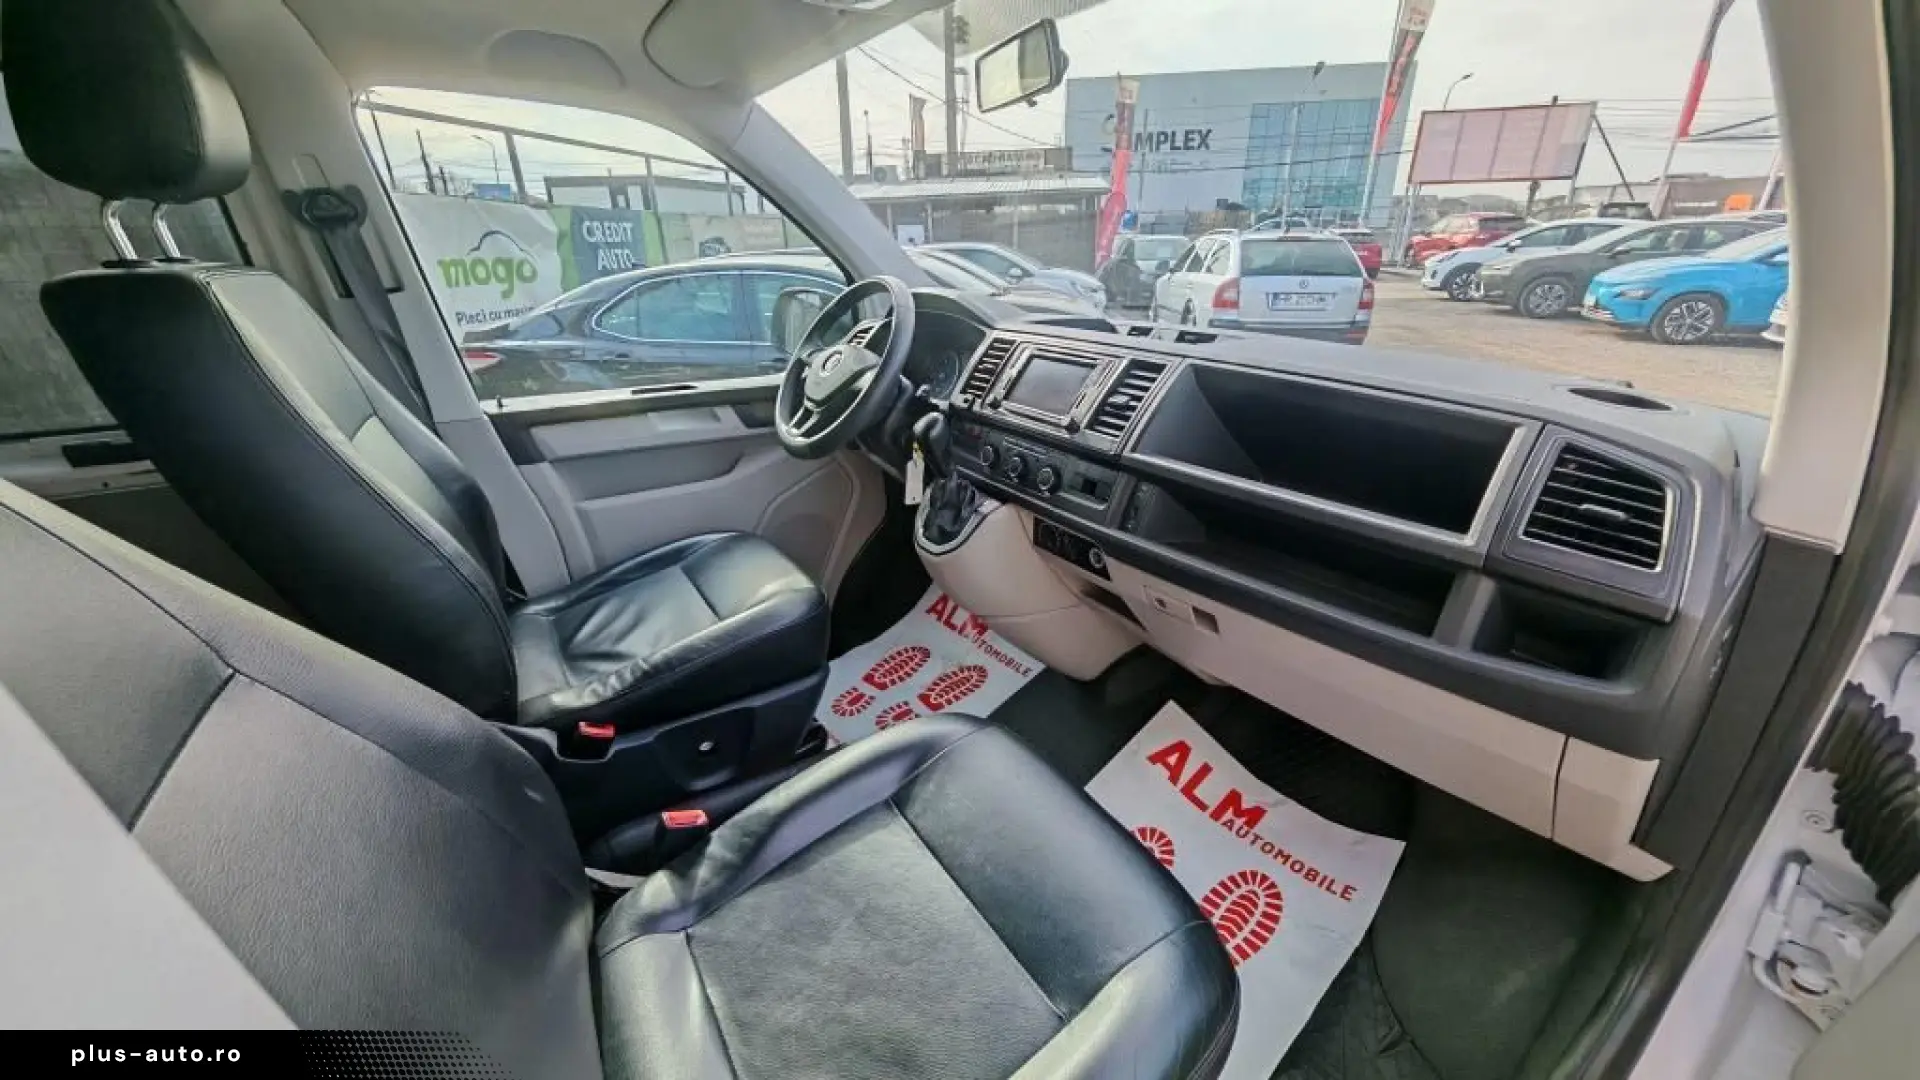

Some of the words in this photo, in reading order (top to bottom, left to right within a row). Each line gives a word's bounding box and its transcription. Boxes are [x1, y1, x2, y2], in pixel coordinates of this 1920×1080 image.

[582, 220, 633, 243] CREDIT
[437, 256, 538, 299] mogo
[597, 248, 633, 271] AUTO
[925, 592, 989, 635] ALM
[1146, 740, 1268, 829] ALM
[1221, 818, 1358, 901] AUTOMOBILE
